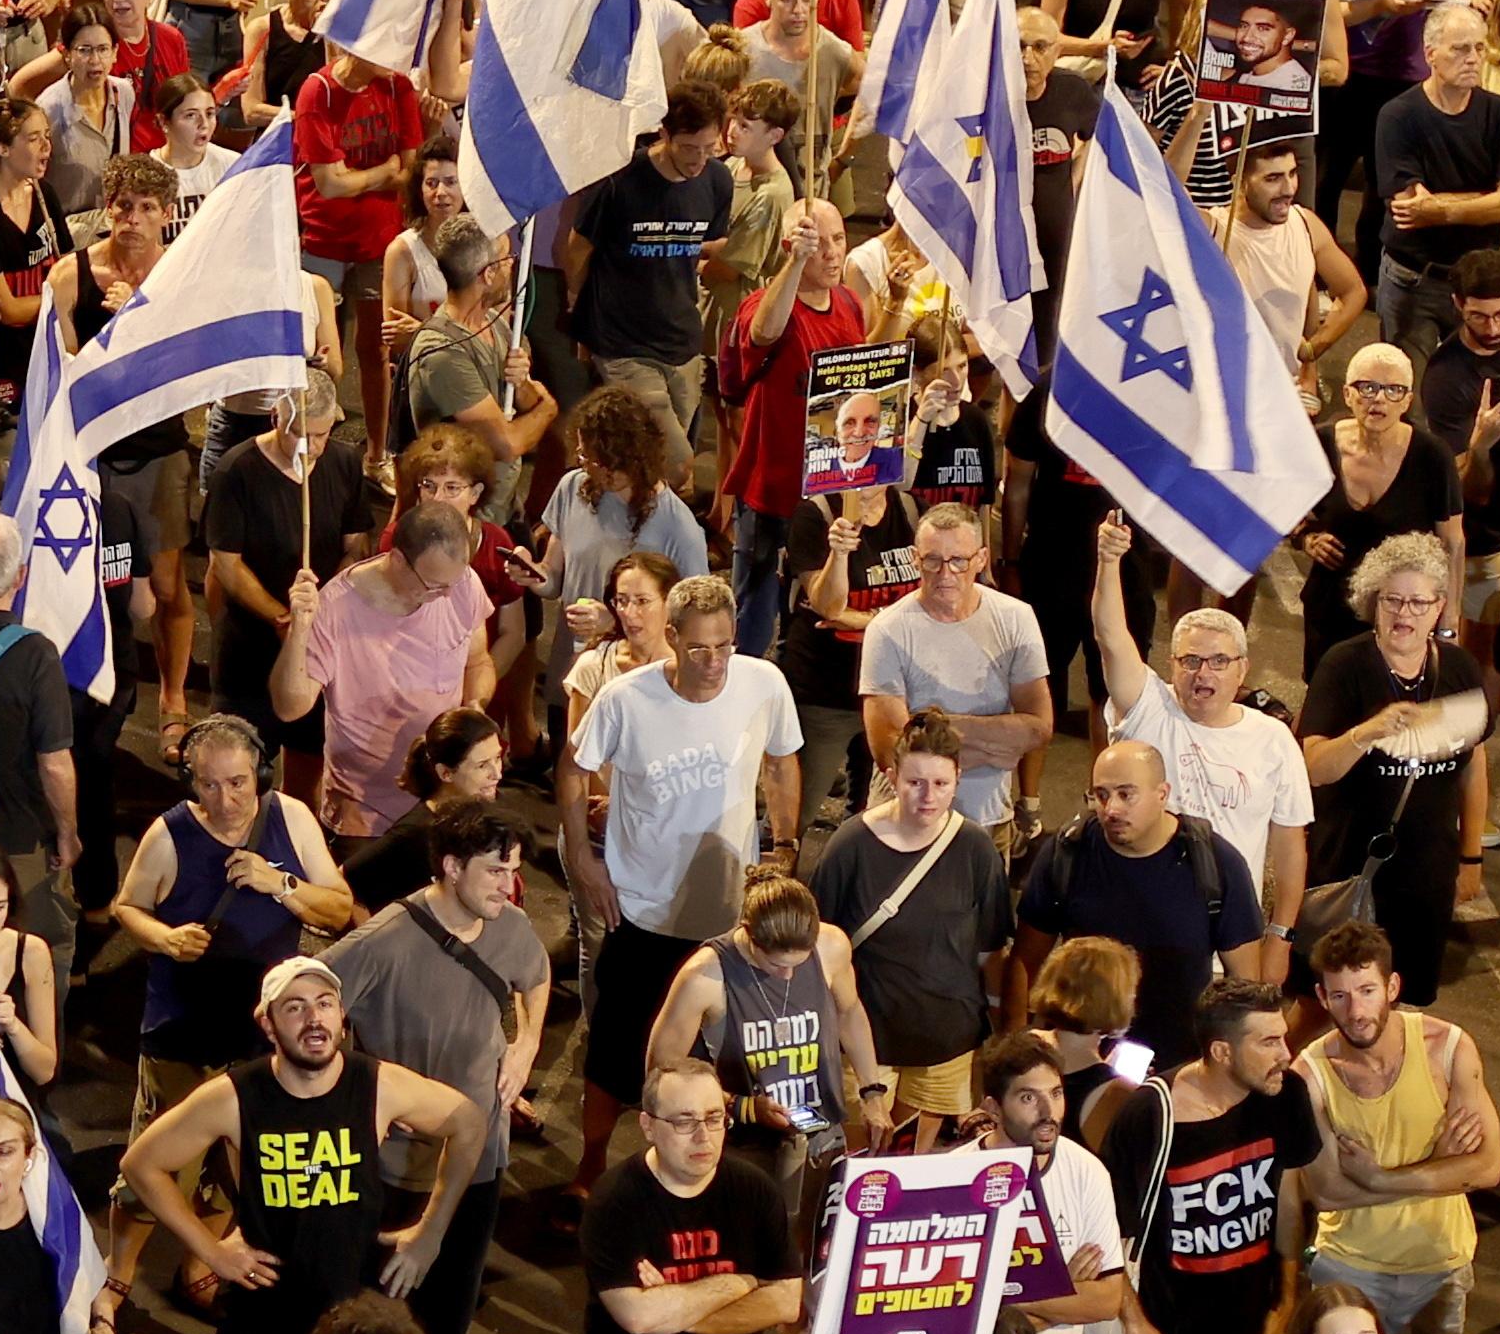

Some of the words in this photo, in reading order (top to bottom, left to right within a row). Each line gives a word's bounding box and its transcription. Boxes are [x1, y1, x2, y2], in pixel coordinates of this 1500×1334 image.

[816, 366, 833, 377] Held
[833, 362, 868, 376] hostage
[878, 357, 906, 369] Hamas
[817, 353, 851, 367] SHLOMO
[852, 348, 890, 364] MANTZUR
[890, 344, 907, 357] 86
[841, 372, 866, 388] 288
[869, 368, 895, 382] DAYS!
[808, 447, 846, 462] BRING
[808, 461, 831, 475] HIM
[646, 742, 719, 782] BADA
[259, 1127, 362, 1171] SEAL
[302, 1164, 323, 1175] THE
[259, 1168, 361, 1209] DEAL
[1169, 1157, 1274, 1223] FCK
[868, 1211, 987, 1245] המלחמה
[1169, 1205, 1273, 1255] BNGVR
[859, 1241, 982, 1290] רעה
[853, 1279, 975, 1317] לחטופים
